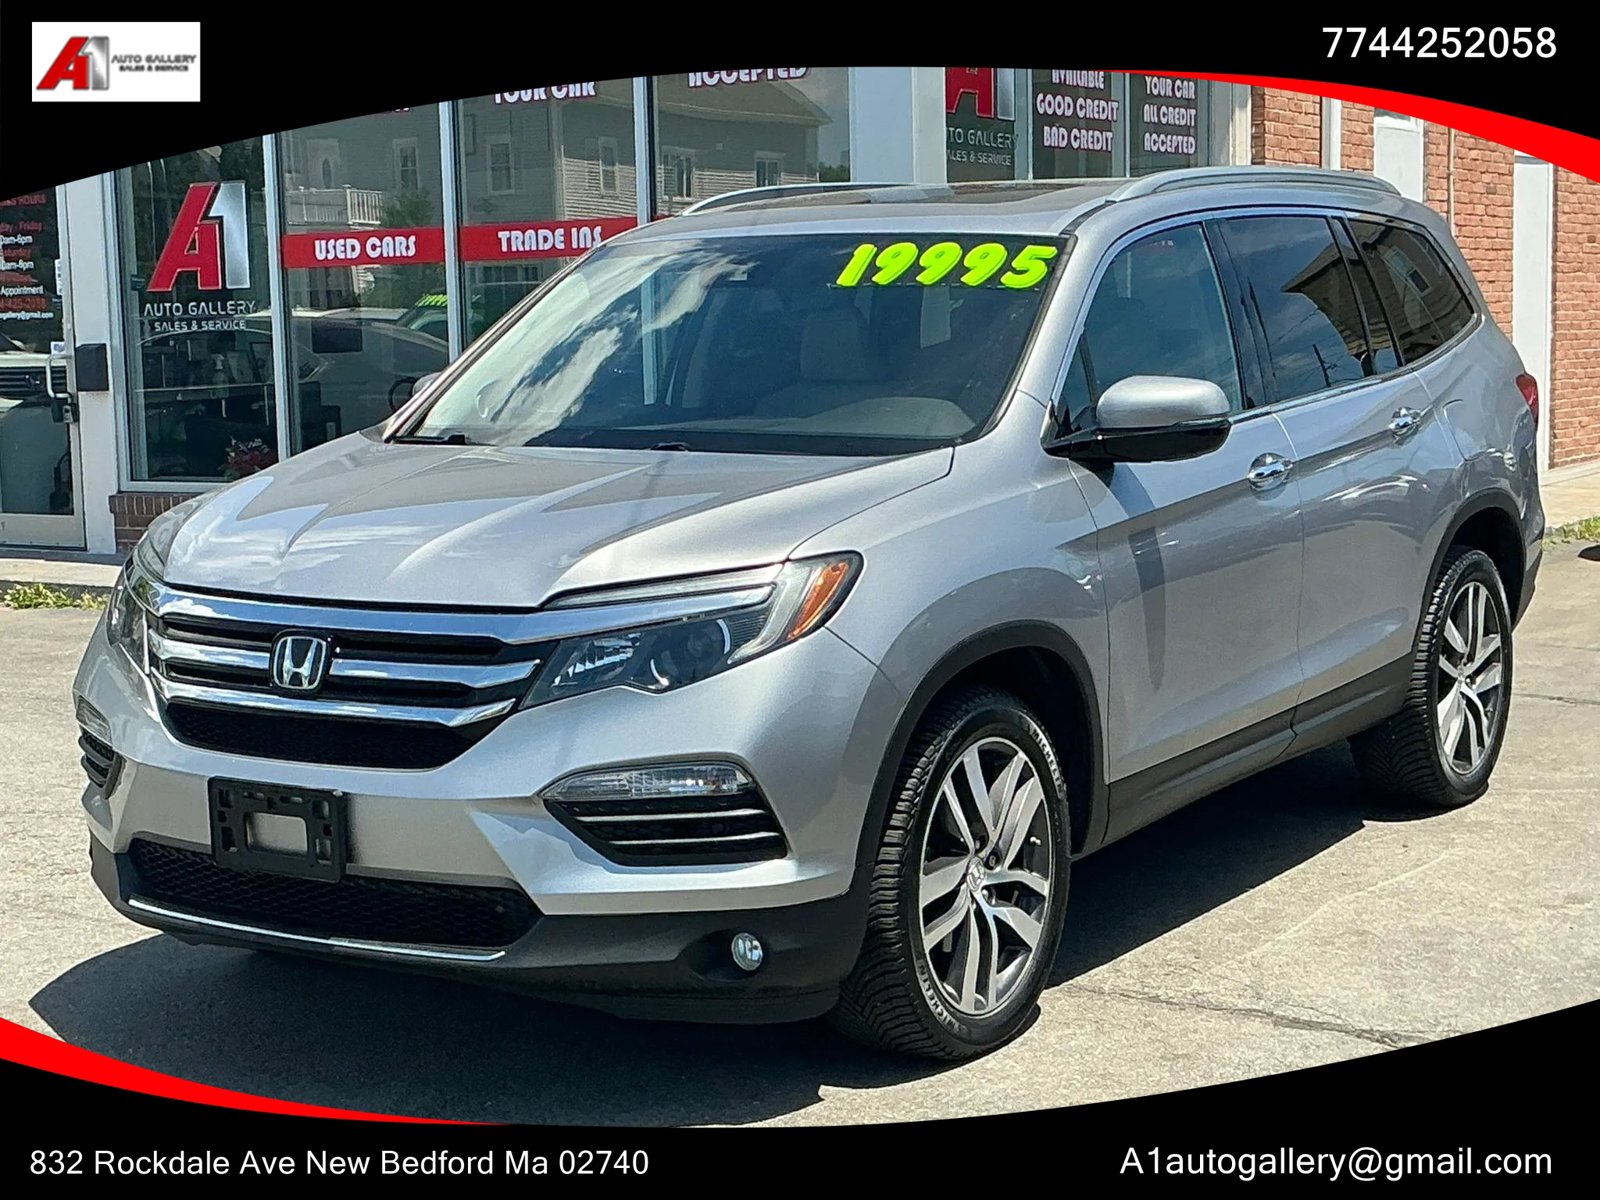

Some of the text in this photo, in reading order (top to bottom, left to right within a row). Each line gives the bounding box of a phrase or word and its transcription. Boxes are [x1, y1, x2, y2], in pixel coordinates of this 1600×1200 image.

[688, 67, 807, 87] ACCEPTED
[1052, 69, 1105, 90] AVAILABLE
[1144, 75, 1196, 99] YOUR CAR
[1036, 92, 1074, 117] GOOD
[1076, 97, 1119, 121] CREDIT
[1143, 103, 1196, 127] ALL CREDIT
[948, 127, 964, 143] TO
[1043, 126, 1113, 151] BAD CREDIT
[1143, 132, 1196, 154] ACCEPTED
[977, 152, 1012, 166] SERVICE
[146, 180, 250, 292] A1
[498, 225, 602, 252] TRADE INS
[314, 235, 416, 261] USED CARS
[835, 240, 1059, 289] 19995
[0, 285, 44, 297] Appointment
[144, 300, 256, 317] AUTO GALLERY
[154, 319, 246, 332] SALES & SERVICE
